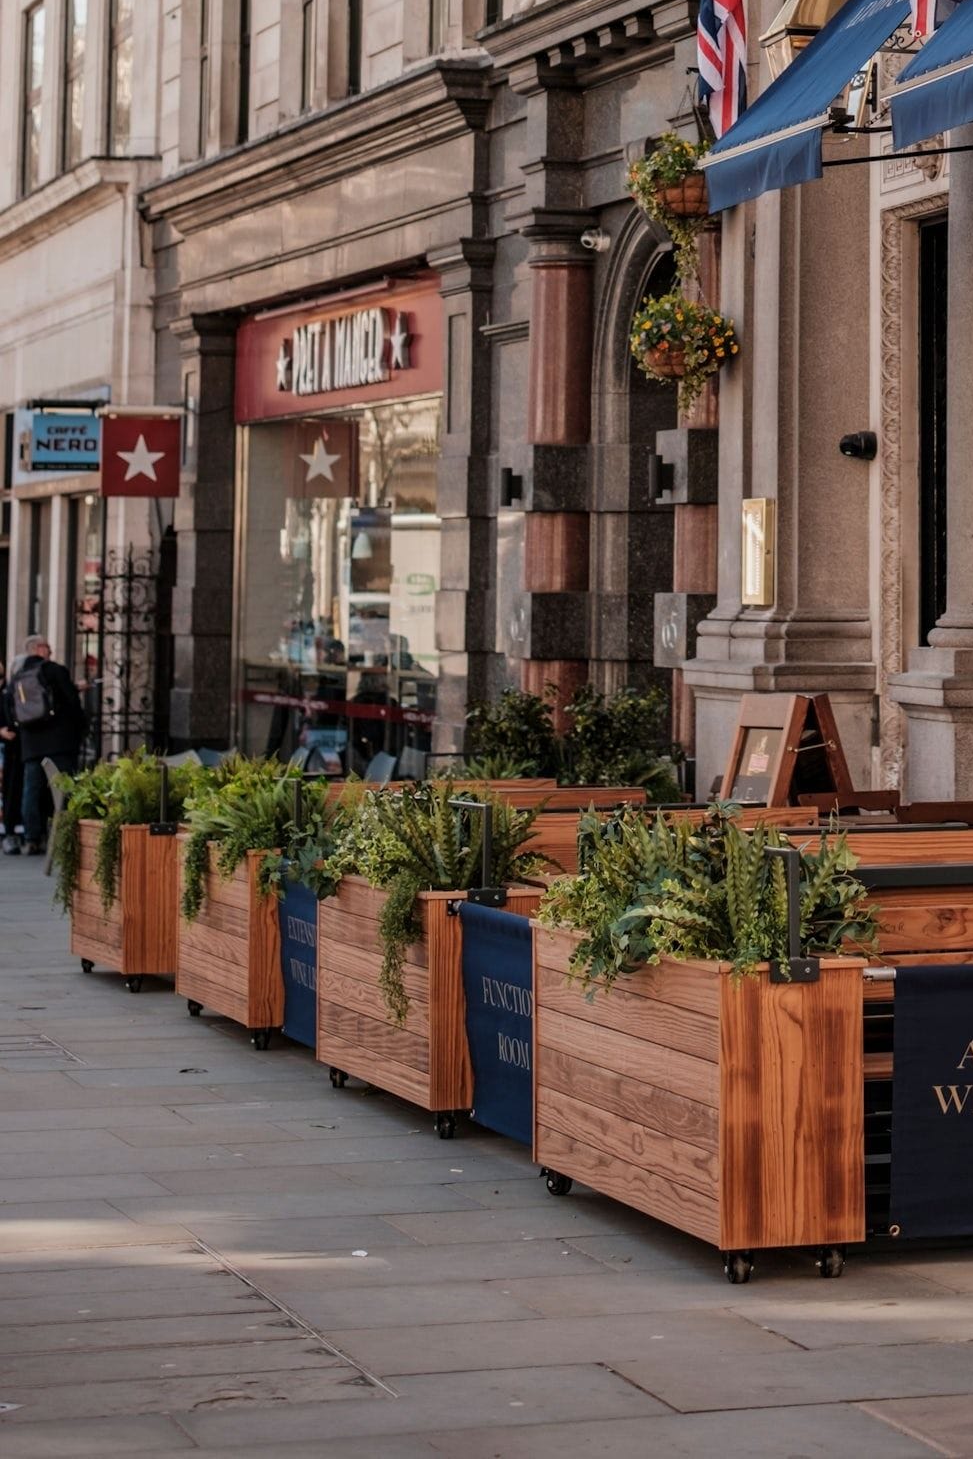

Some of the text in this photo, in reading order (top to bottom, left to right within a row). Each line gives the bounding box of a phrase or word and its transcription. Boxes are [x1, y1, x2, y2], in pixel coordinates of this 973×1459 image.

[292, 321, 321, 396] PRET
[334, 307, 384, 390] MANGER
[36, 439, 97, 452] NERO
[498, 1032, 530, 1070] ROOM
